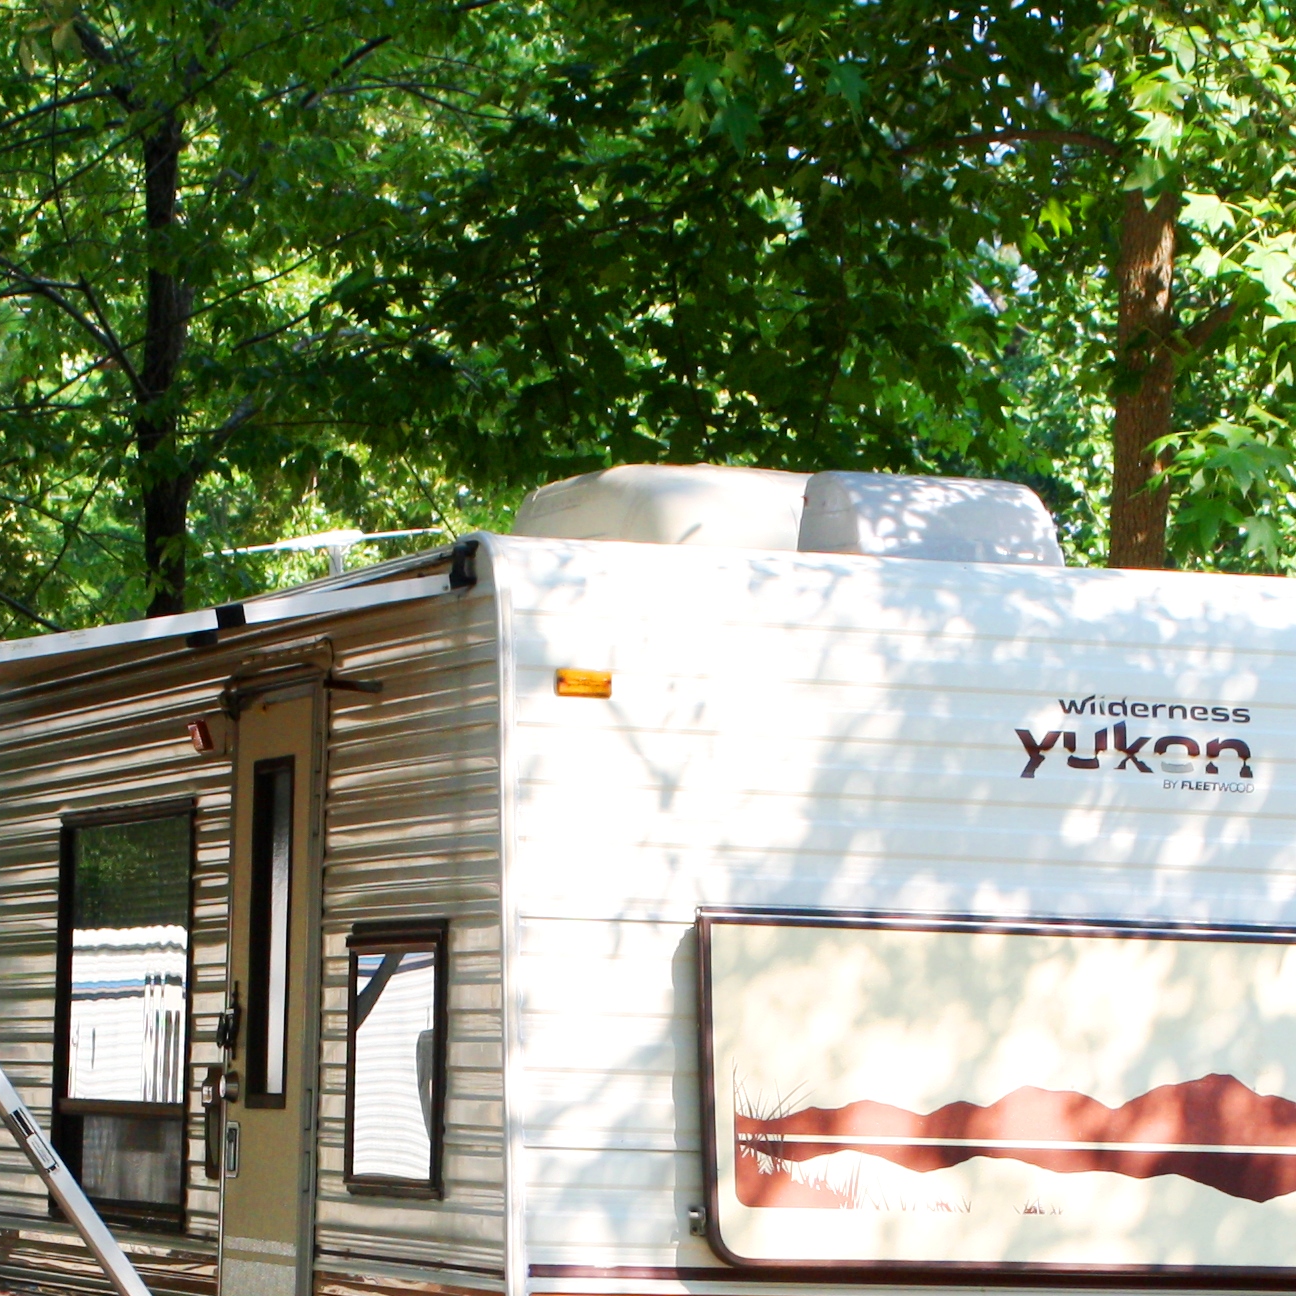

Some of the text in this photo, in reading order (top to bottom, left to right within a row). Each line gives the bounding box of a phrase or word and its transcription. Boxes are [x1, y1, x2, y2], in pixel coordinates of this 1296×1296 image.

[1014, 721, 1253, 778] yukon
[1163, 780, 1254, 793] BY FLEETWOOD
